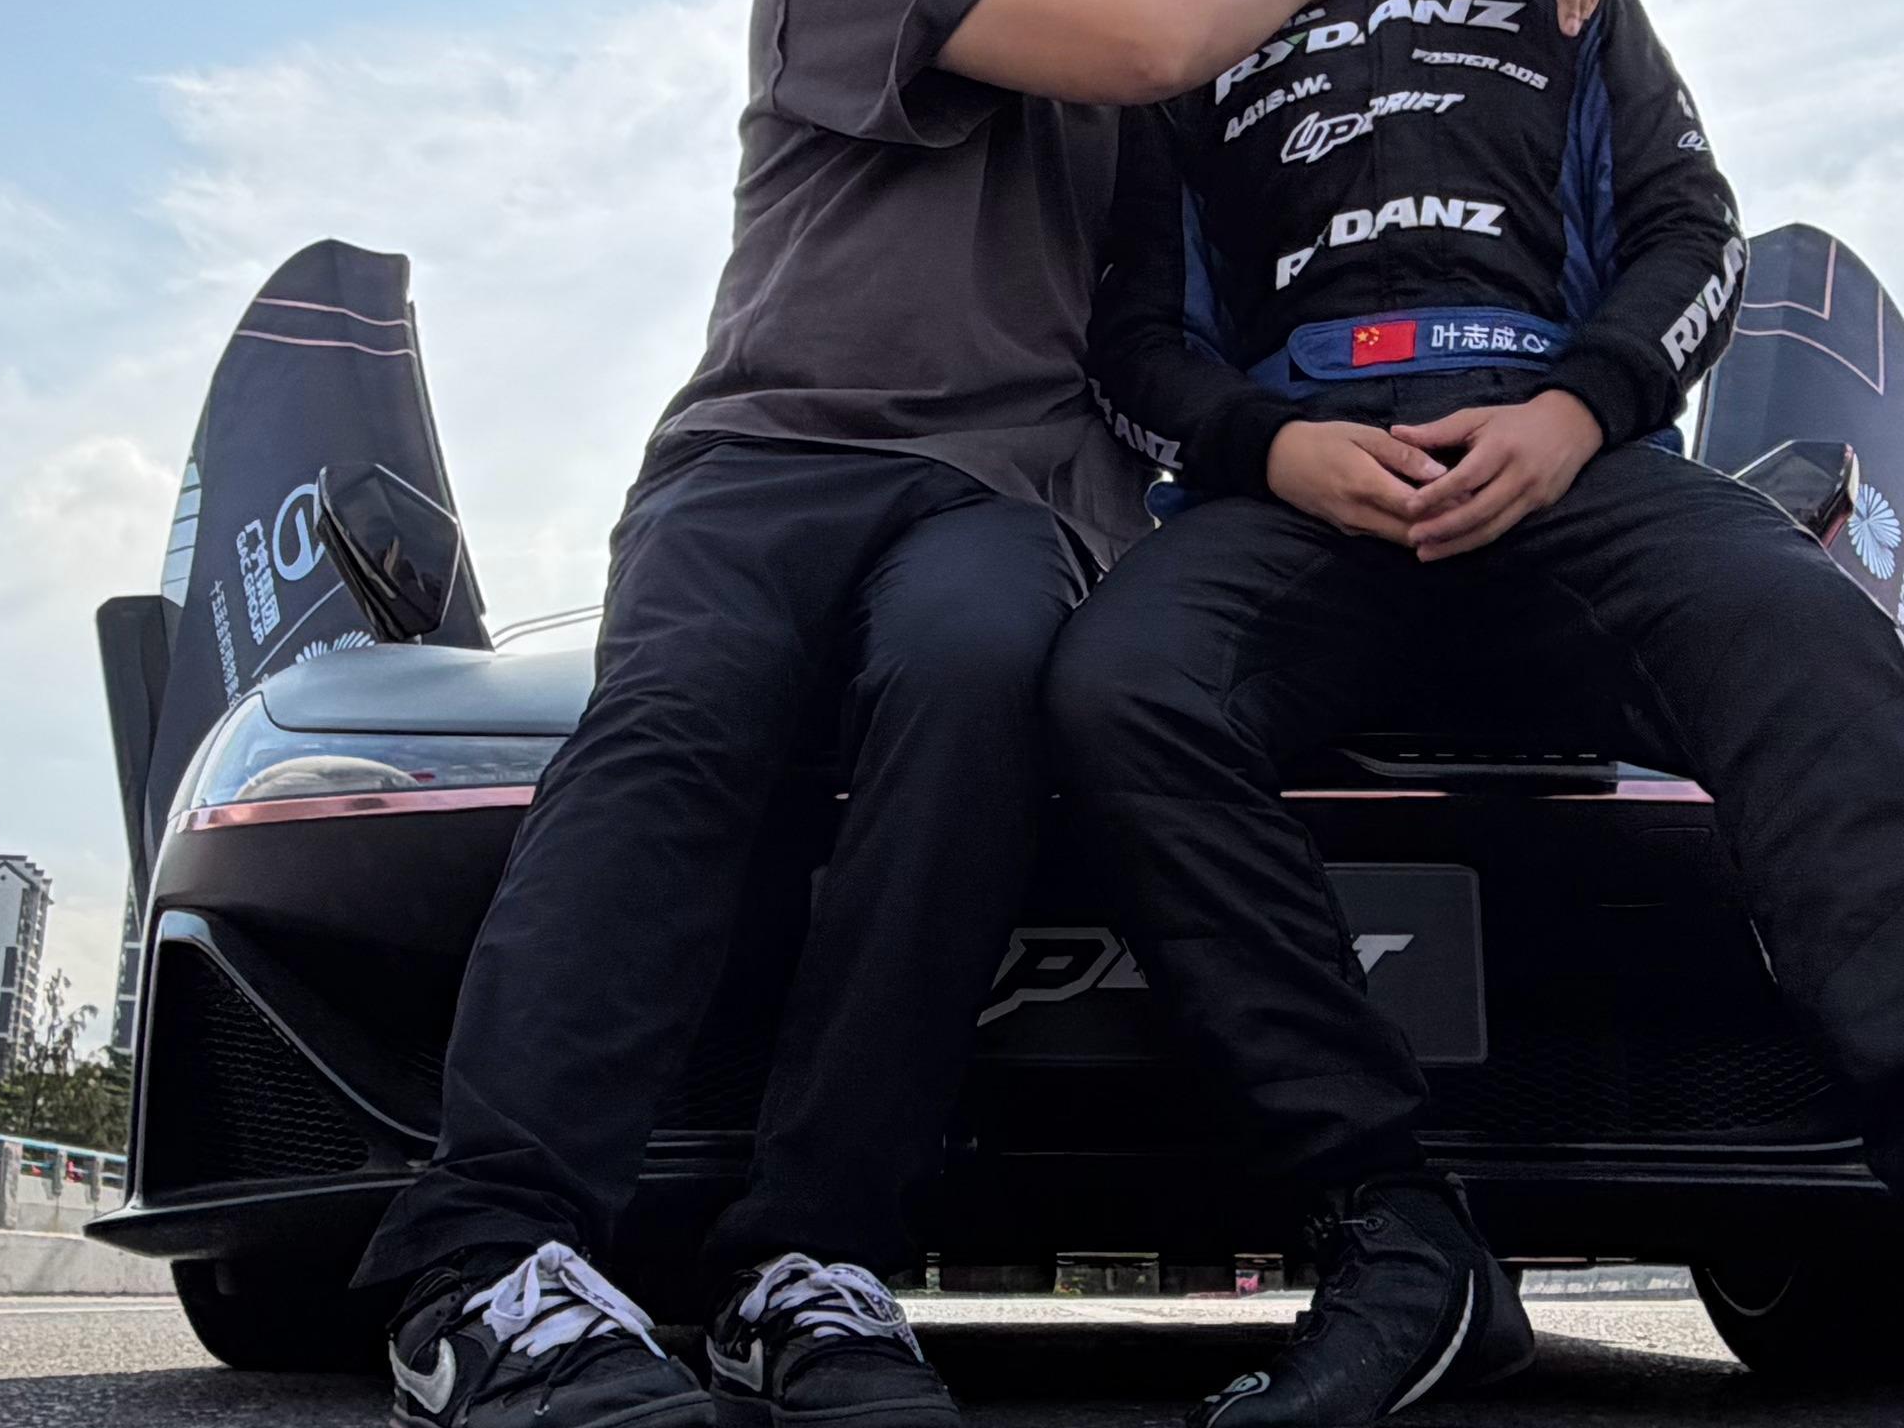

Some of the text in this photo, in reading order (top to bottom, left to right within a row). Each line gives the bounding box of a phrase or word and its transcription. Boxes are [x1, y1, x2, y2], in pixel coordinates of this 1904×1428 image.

[1498, 61, 1549, 91] ADS
[236, 531, 264, 645] GAC GROUP
